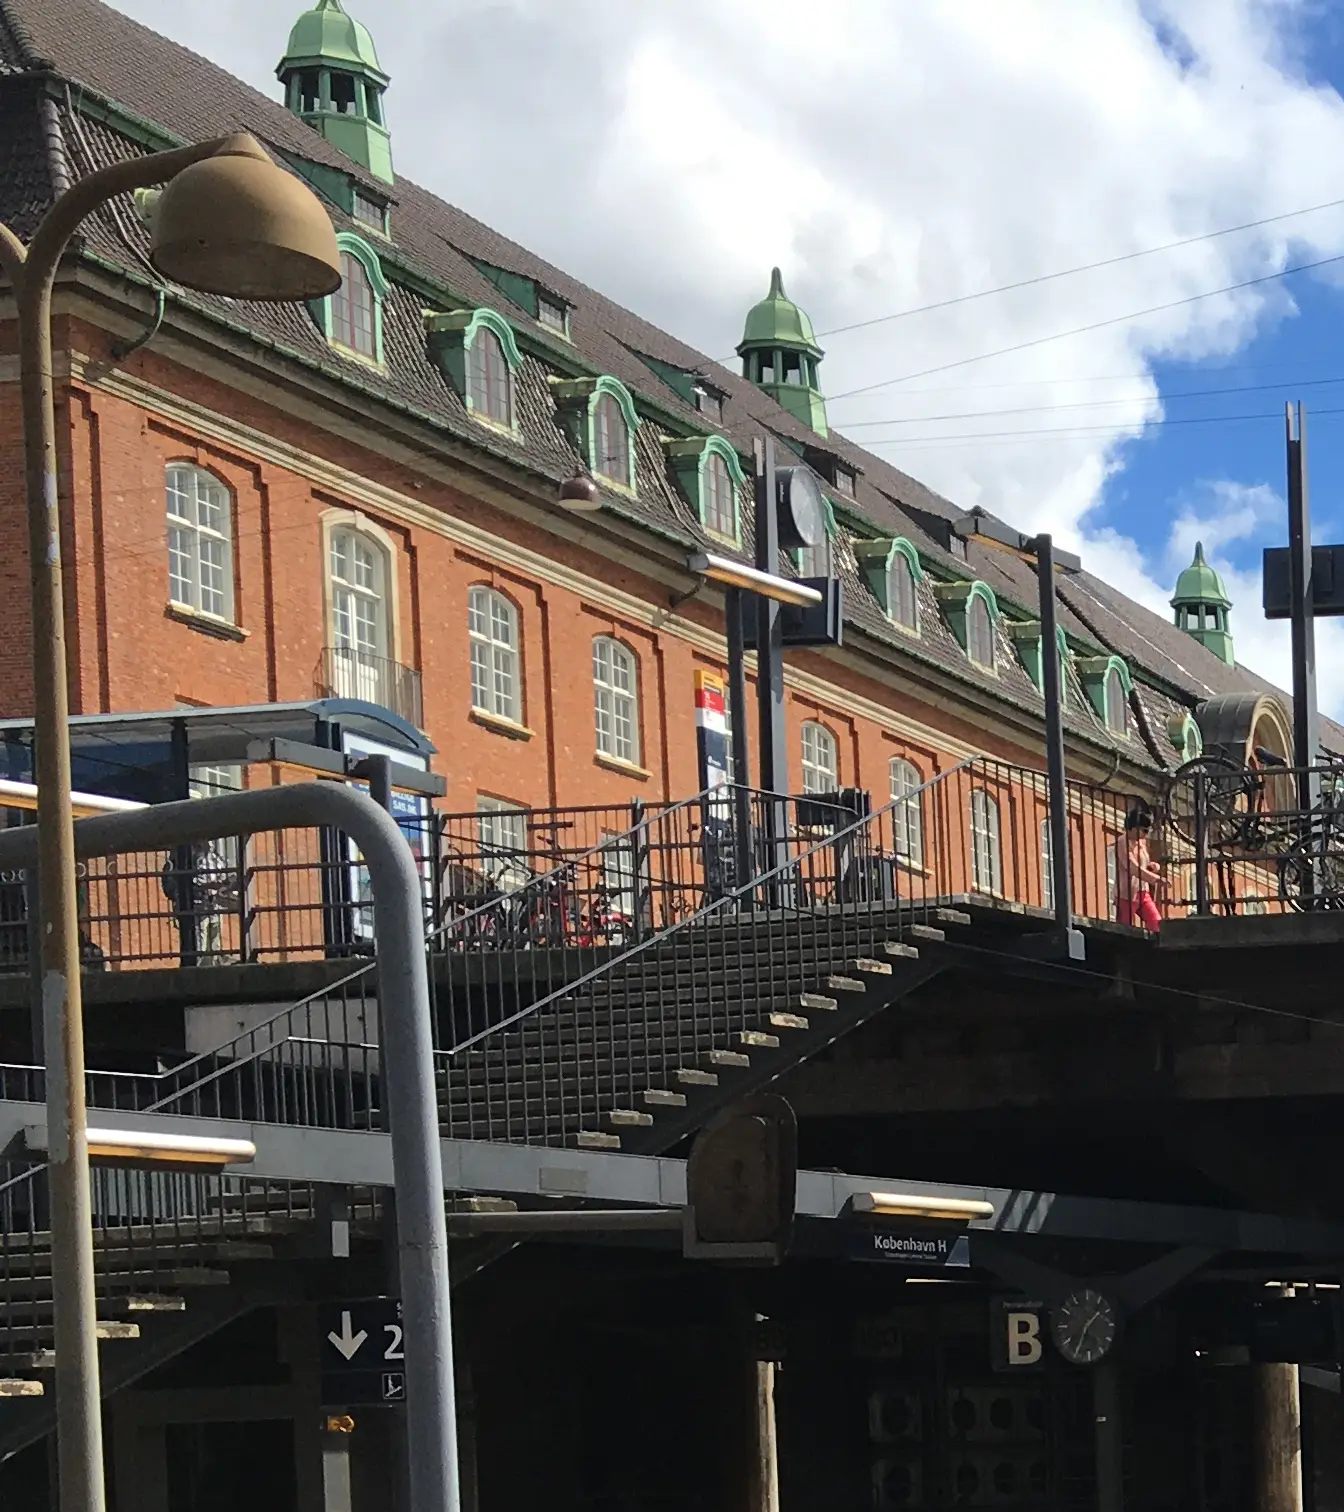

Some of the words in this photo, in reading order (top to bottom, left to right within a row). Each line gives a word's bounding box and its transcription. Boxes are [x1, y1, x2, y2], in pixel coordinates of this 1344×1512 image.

[873, 1235, 936, 1253] København
[938, 1240, 947, 1253] H
[383, 1324, 404, 1360] 2
[1007, 1311, 1043, 1366] B
